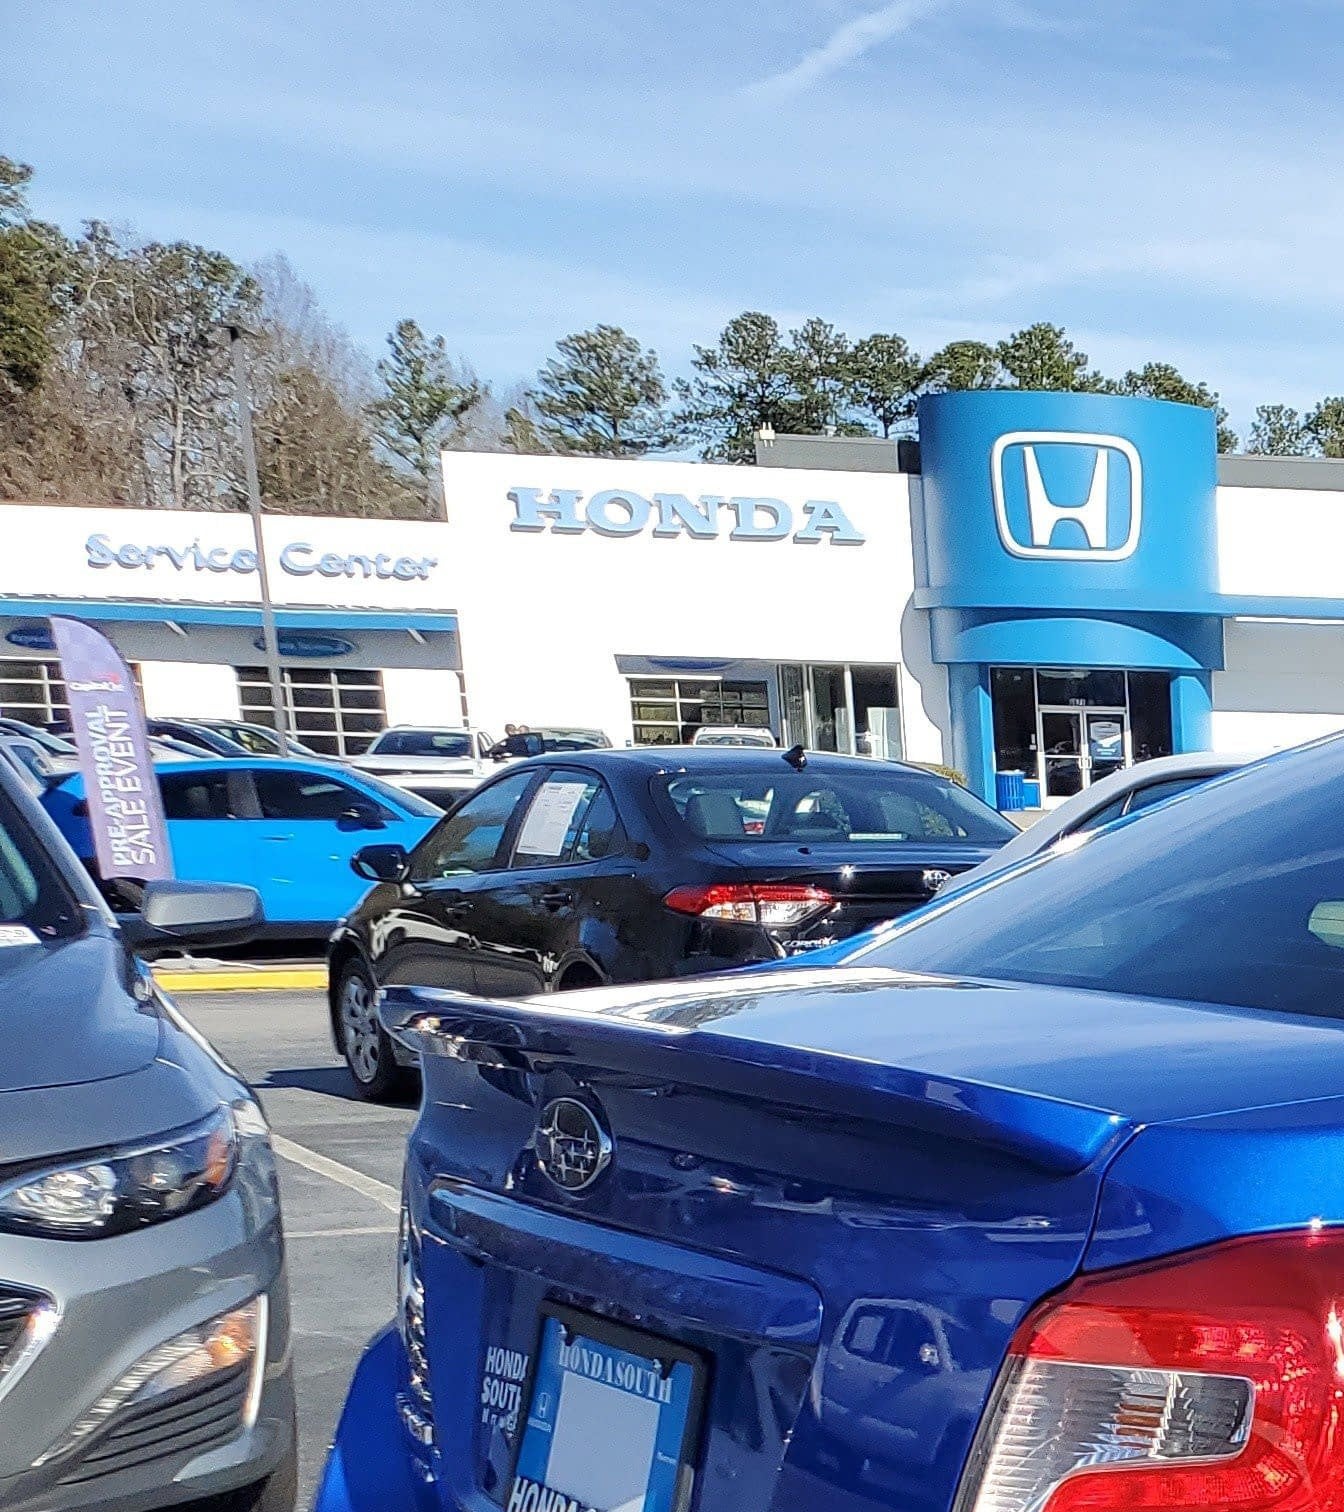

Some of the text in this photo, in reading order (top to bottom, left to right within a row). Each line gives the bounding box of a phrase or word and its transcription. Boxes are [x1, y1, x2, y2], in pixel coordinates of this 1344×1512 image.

[85, 533, 438, 580] Service Center
[506, 487, 866, 545] HONDA
[84, 704, 133, 866] PRE-APPROVAL
[106, 709, 156, 865] SALE EVENT
